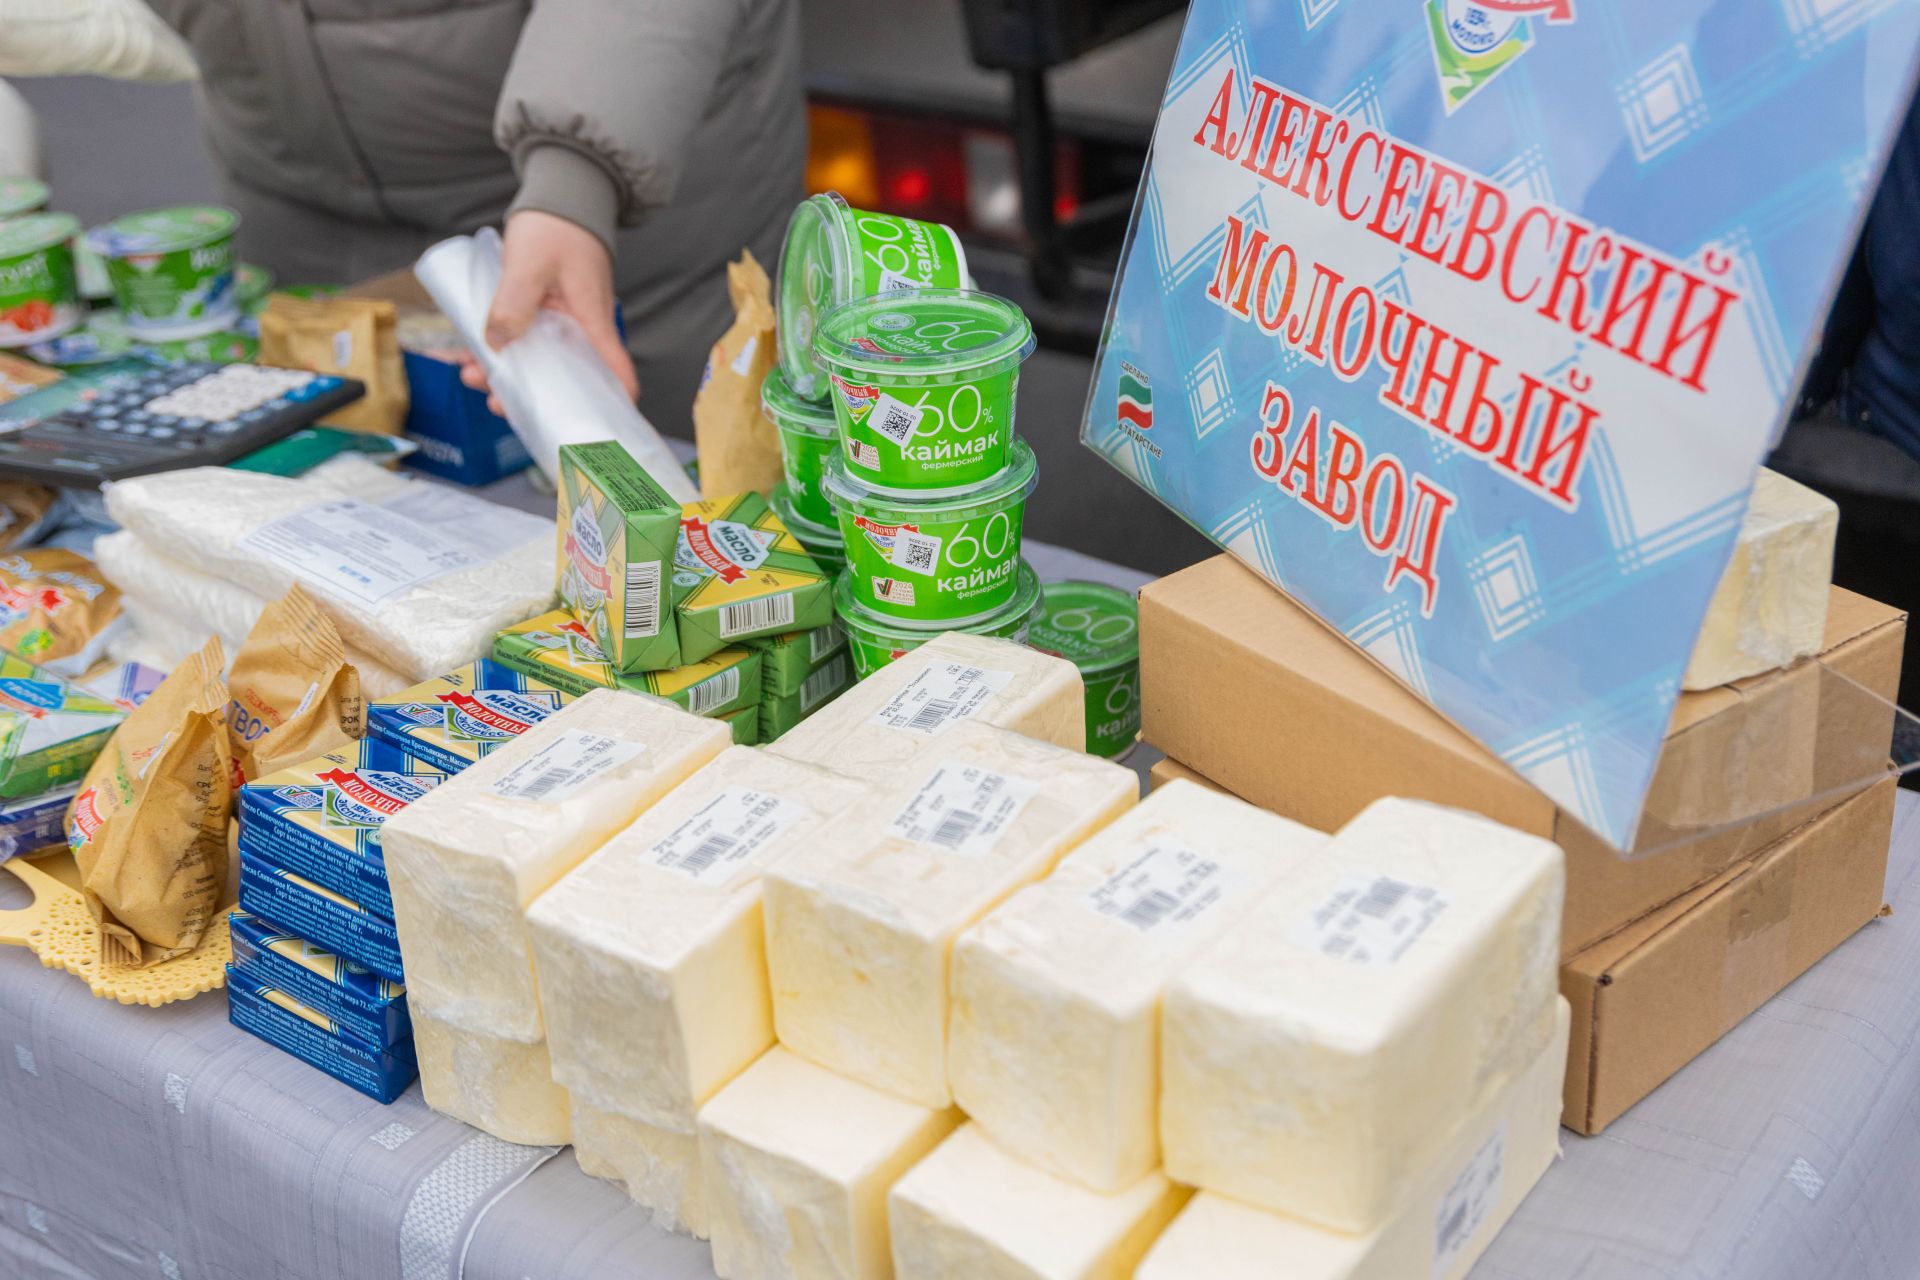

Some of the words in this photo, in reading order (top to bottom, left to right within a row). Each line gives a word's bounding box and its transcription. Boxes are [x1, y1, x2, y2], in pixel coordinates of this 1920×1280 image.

[1193, 67, 1740, 395] АЛЕКСЕЕВСКИЙ
[906, 218, 933, 288] кайма
[1121, 360, 1149, 384] сделано
[1207, 216, 1601, 505] МОЛОЧНЫЙ
[900, 430, 999, 462] каймак
[1123, 424, 1162, 458] ТАТАРСТАНЕ
[920, 454, 984, 472] фермерский
[1253, 384, 1454, 611] ЗАВОД
[936, 552, 1020, 593] каймак
[461, 701, 528, 735] МОЛОЧНЫ
[367, 773, 424, 799] масл
[241, 800, 256, 814] Масло
[256, 807, 284, 829] Сливочное
[285, 822, 322, 848] Крестьянское.
[323, 841, 348, 861] Массовая
[273, 825, 284, 839] Сорт
[310, 844, 325, 859] Масса
[241, 862, 256, 876] Масло
[257, 869, 285, 890] Сливочное
[286, 883, 324, 907] Крестьянское.
[325, 901, 351, 920] Массовая
[383, 927, 395, 939] 72,5
[275, 887, 287, 899] Сорт
[312, 905, 328, 918] Масса
